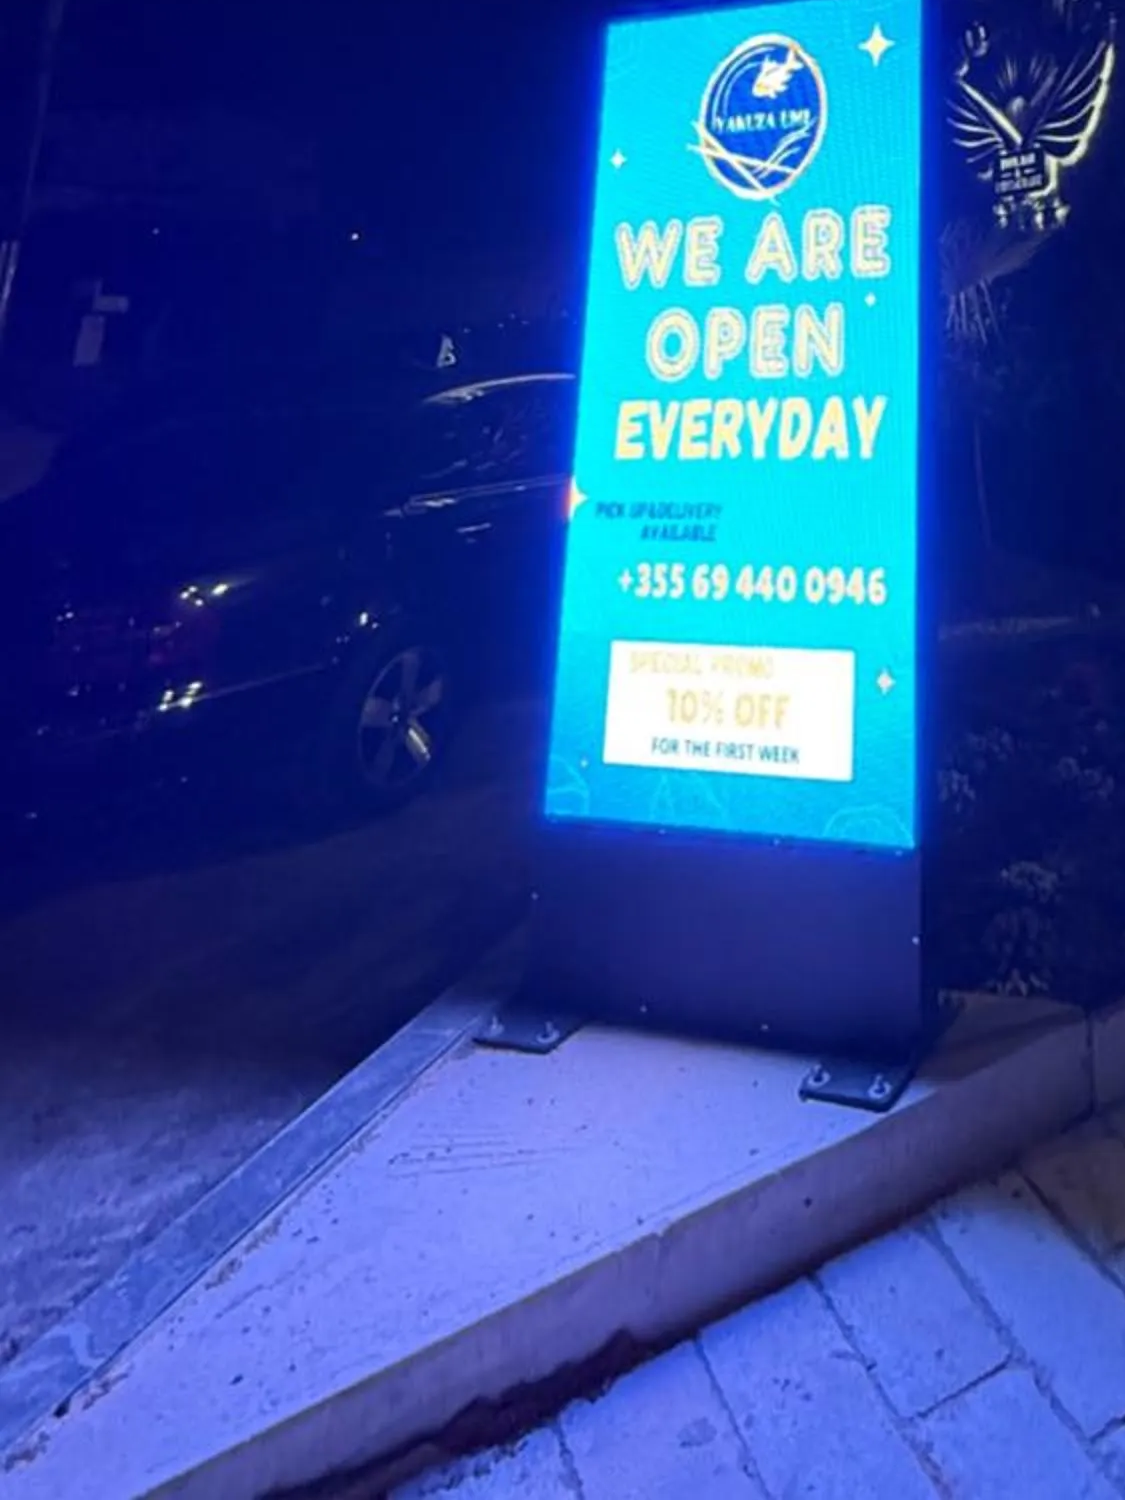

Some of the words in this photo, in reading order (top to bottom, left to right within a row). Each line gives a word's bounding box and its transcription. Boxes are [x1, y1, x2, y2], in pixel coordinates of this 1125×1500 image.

[616, 215, 722, 290] WE
[746, 205, 892, 284] ARE
[645, 303, 845, 382] OPEN
[614, 396, 887, 461] EVERYDAY
[640, 524, 717, 542] AVAILABLE
[618, 563, 684, 599] +355
[692, 563, 729, 600] 69
[736, 565, 797, 602] 440
[805, 567, 887, 606] 0946
[667, 687, 725, 726] 10%
[734, 694, 790, 729] OFF
[651, 737, 679, 756] FOR
[685, 739, 710, 758] THE
[716, 741, 754, 762] FIRST
[759, 744, 800, 765] WEEK
